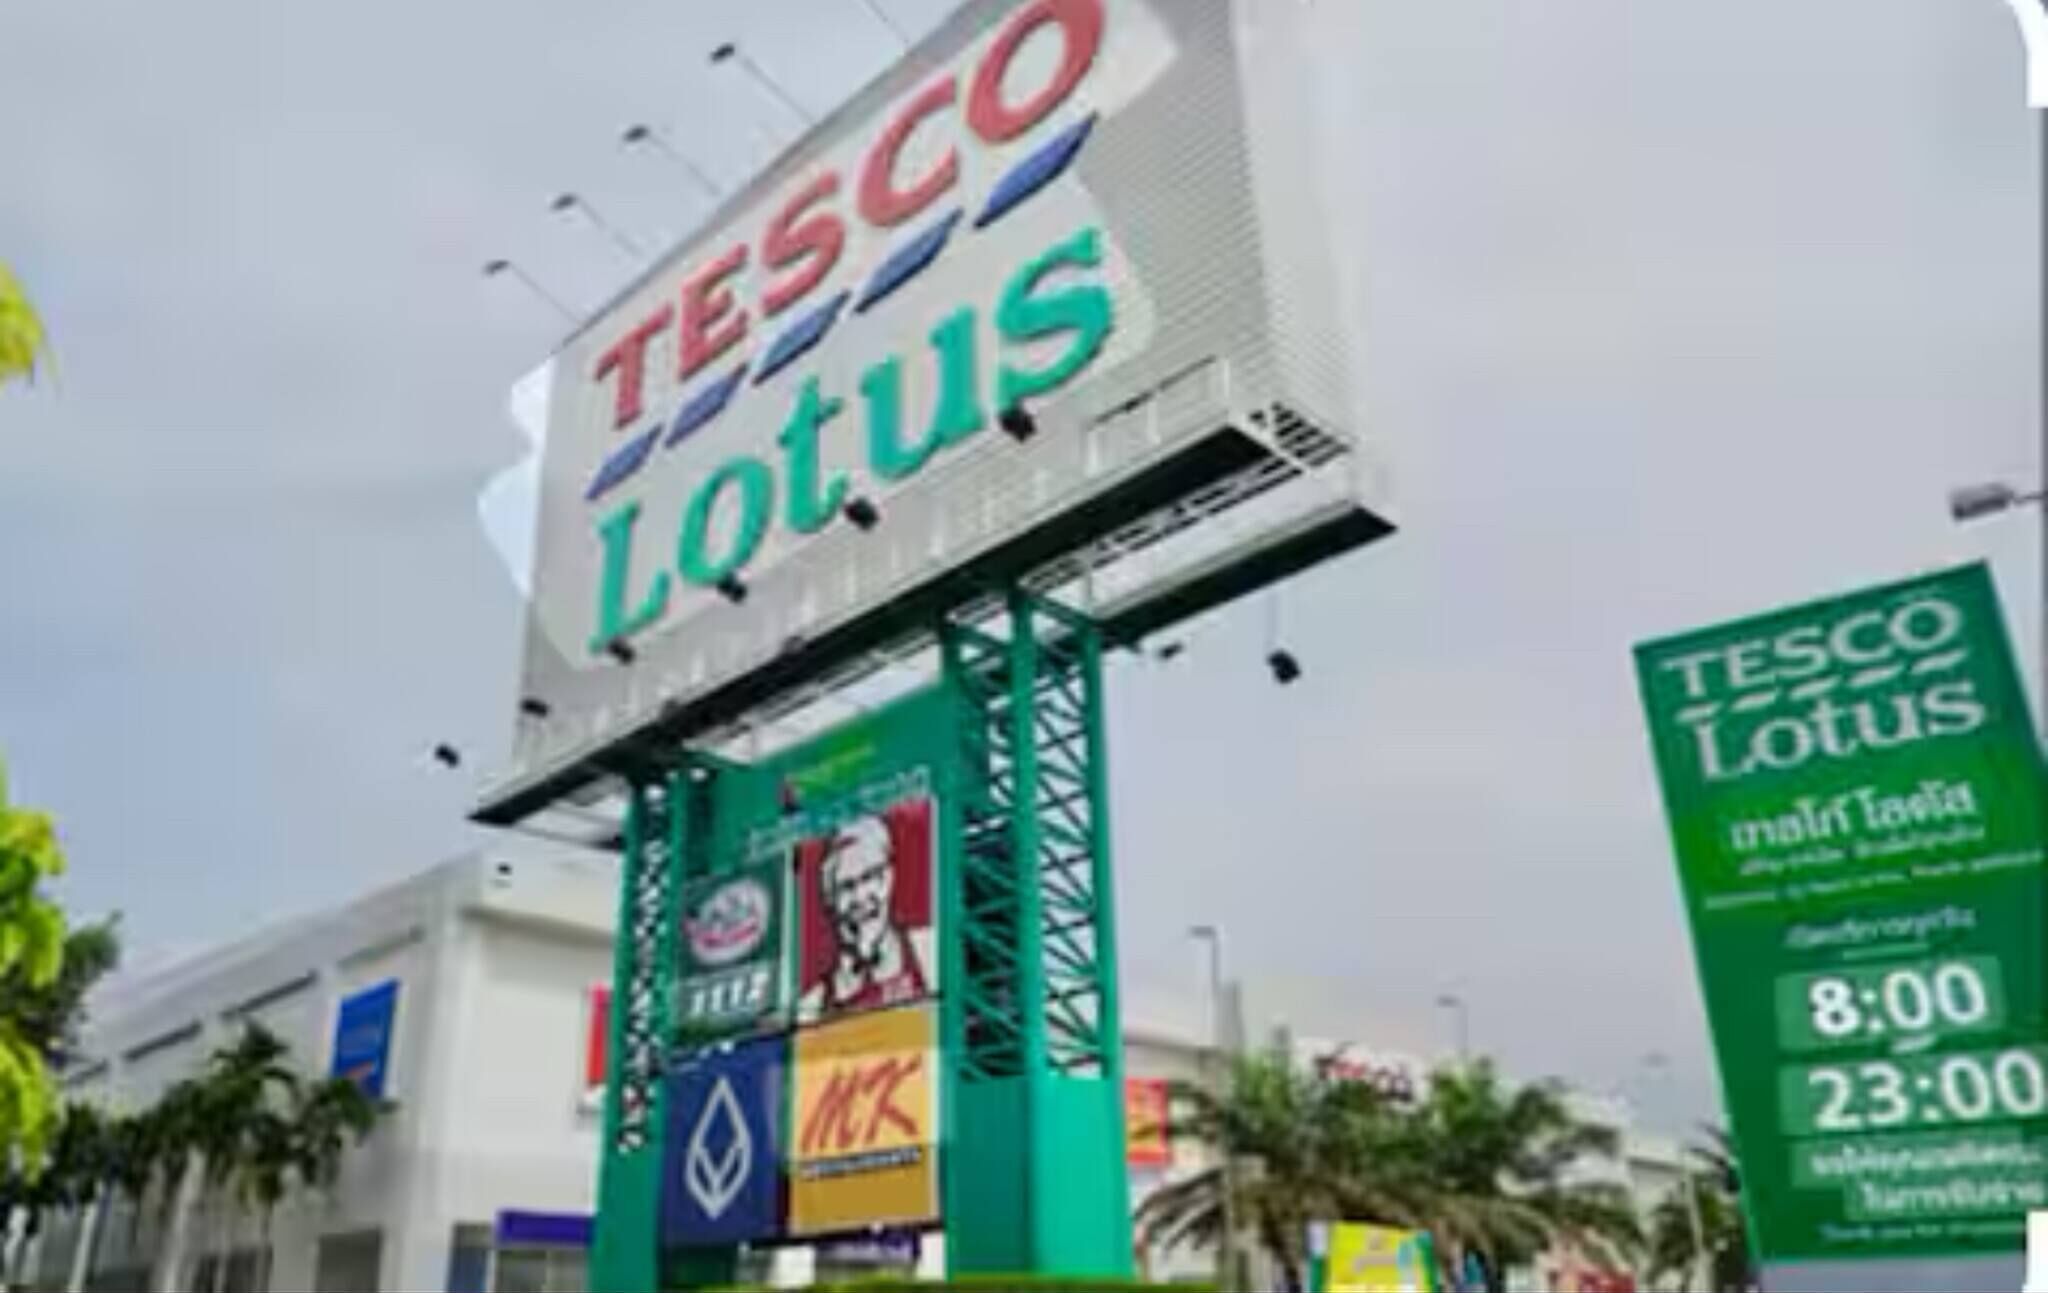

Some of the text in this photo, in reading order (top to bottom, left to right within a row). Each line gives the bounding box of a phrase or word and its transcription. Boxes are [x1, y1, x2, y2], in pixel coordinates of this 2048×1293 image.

[594, 0, 1107, 430] TESCO
[588, 226, 1115, 655] Lotus
[1658, 598, 1963, 698] TESCO
[1694, 681, 1986, 782] Lotus
[1809, 961, 1988, 1036] 8:00
[799, 1053, 922, 1152] MK
[1808, 1048, 2046, 1131] 23:00
